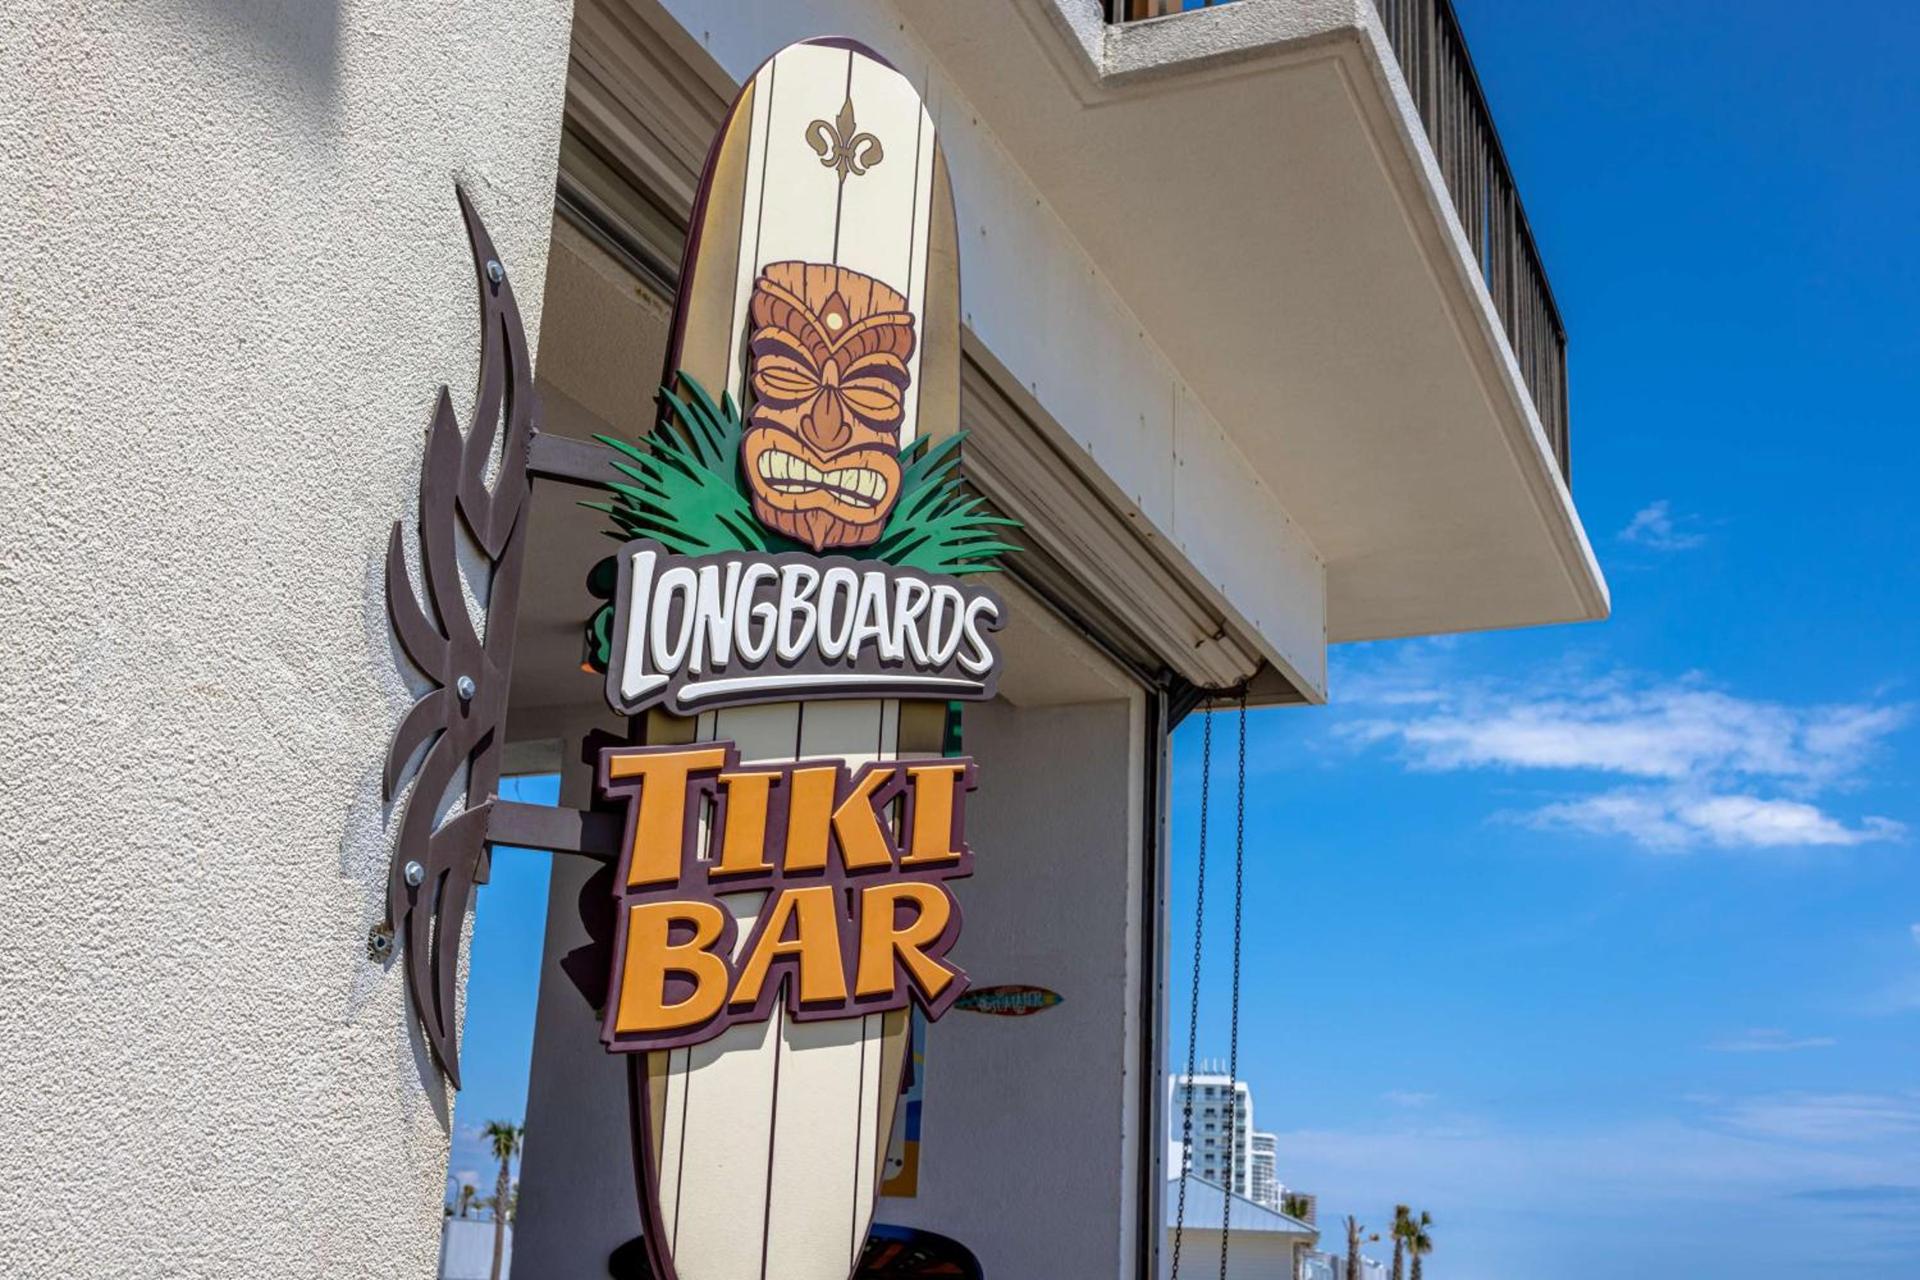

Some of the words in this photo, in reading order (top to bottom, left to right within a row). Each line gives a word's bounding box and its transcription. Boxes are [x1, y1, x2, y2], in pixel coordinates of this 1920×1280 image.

[620, 550, 999, 700] LONGBOARDS
[609, 747, 966, 887] TIKI
[615, 881, 955, 1033] BAR
